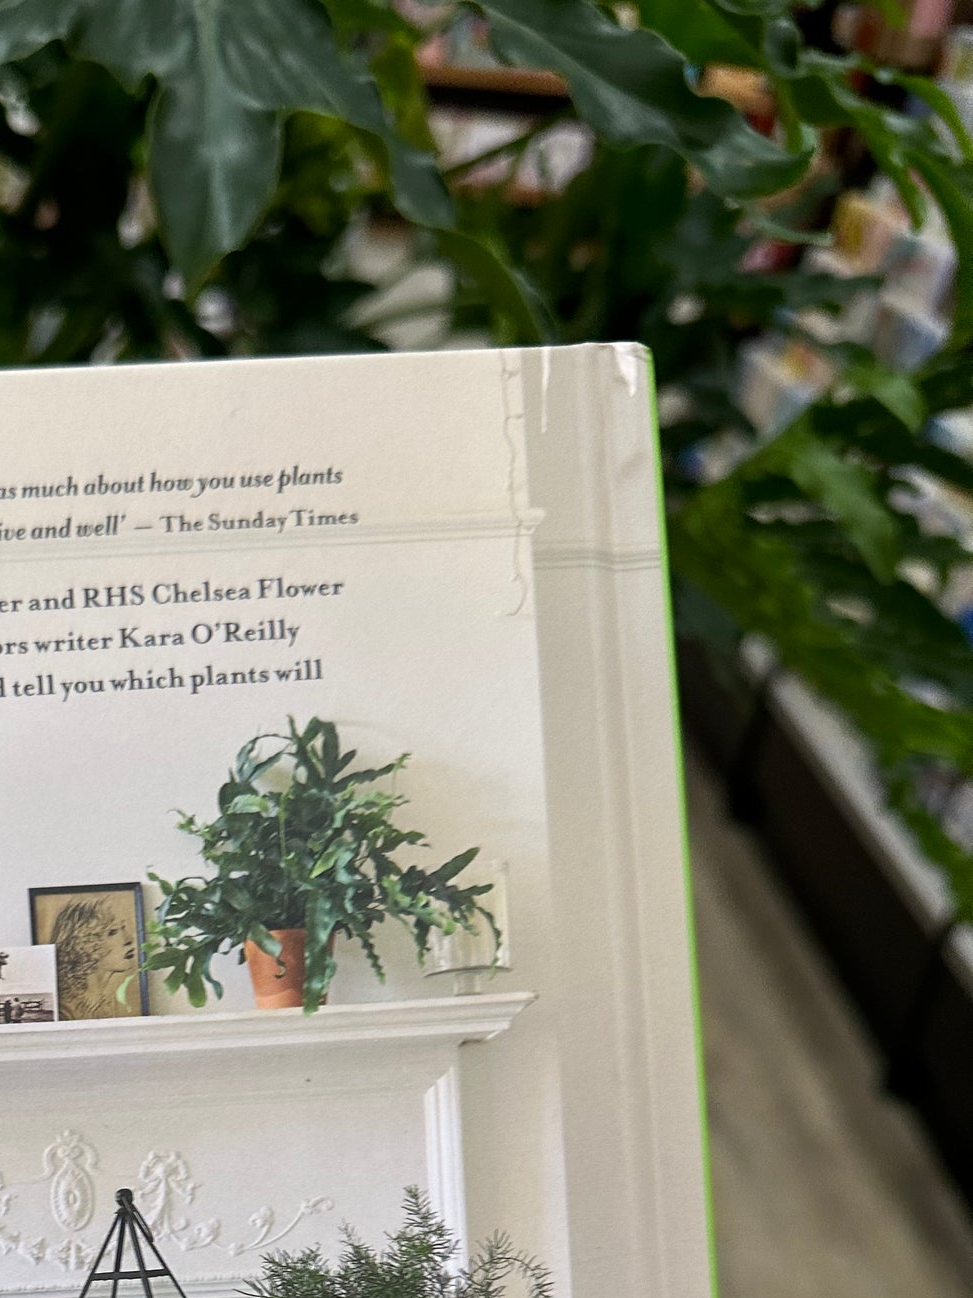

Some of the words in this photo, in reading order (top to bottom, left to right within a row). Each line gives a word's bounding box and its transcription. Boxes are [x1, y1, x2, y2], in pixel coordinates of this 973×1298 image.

[21, 477, 79, 499] much
[82, 473, 145, 496] about
[149, 471, 194, 494] how
[190, 476, 236, 499] you
[239, 473, 274, 489] use
[276, 466, 344, 493] plants
[30, 516, 73, 540] and
[158, 514, 204, 533] The
[207, 510, 288, 534] Sunday
[288, 508, 359, 527] Times
[27, 587, 76, 612] and
[81, 584, 146, 609] RHS
[151, 580, 252, 605] Chelsea
[256, 576, 345, 600] Flower
[33, 631, 114, 653] writer
[118, 626, 186, 649] Kara
[11, 673, 57, 698] tell
[59, 679, 106, 703] you
[109, 667, 187, 691] which
[189, 664, 270, 695] plants
[274, 658, 324, 682] will
